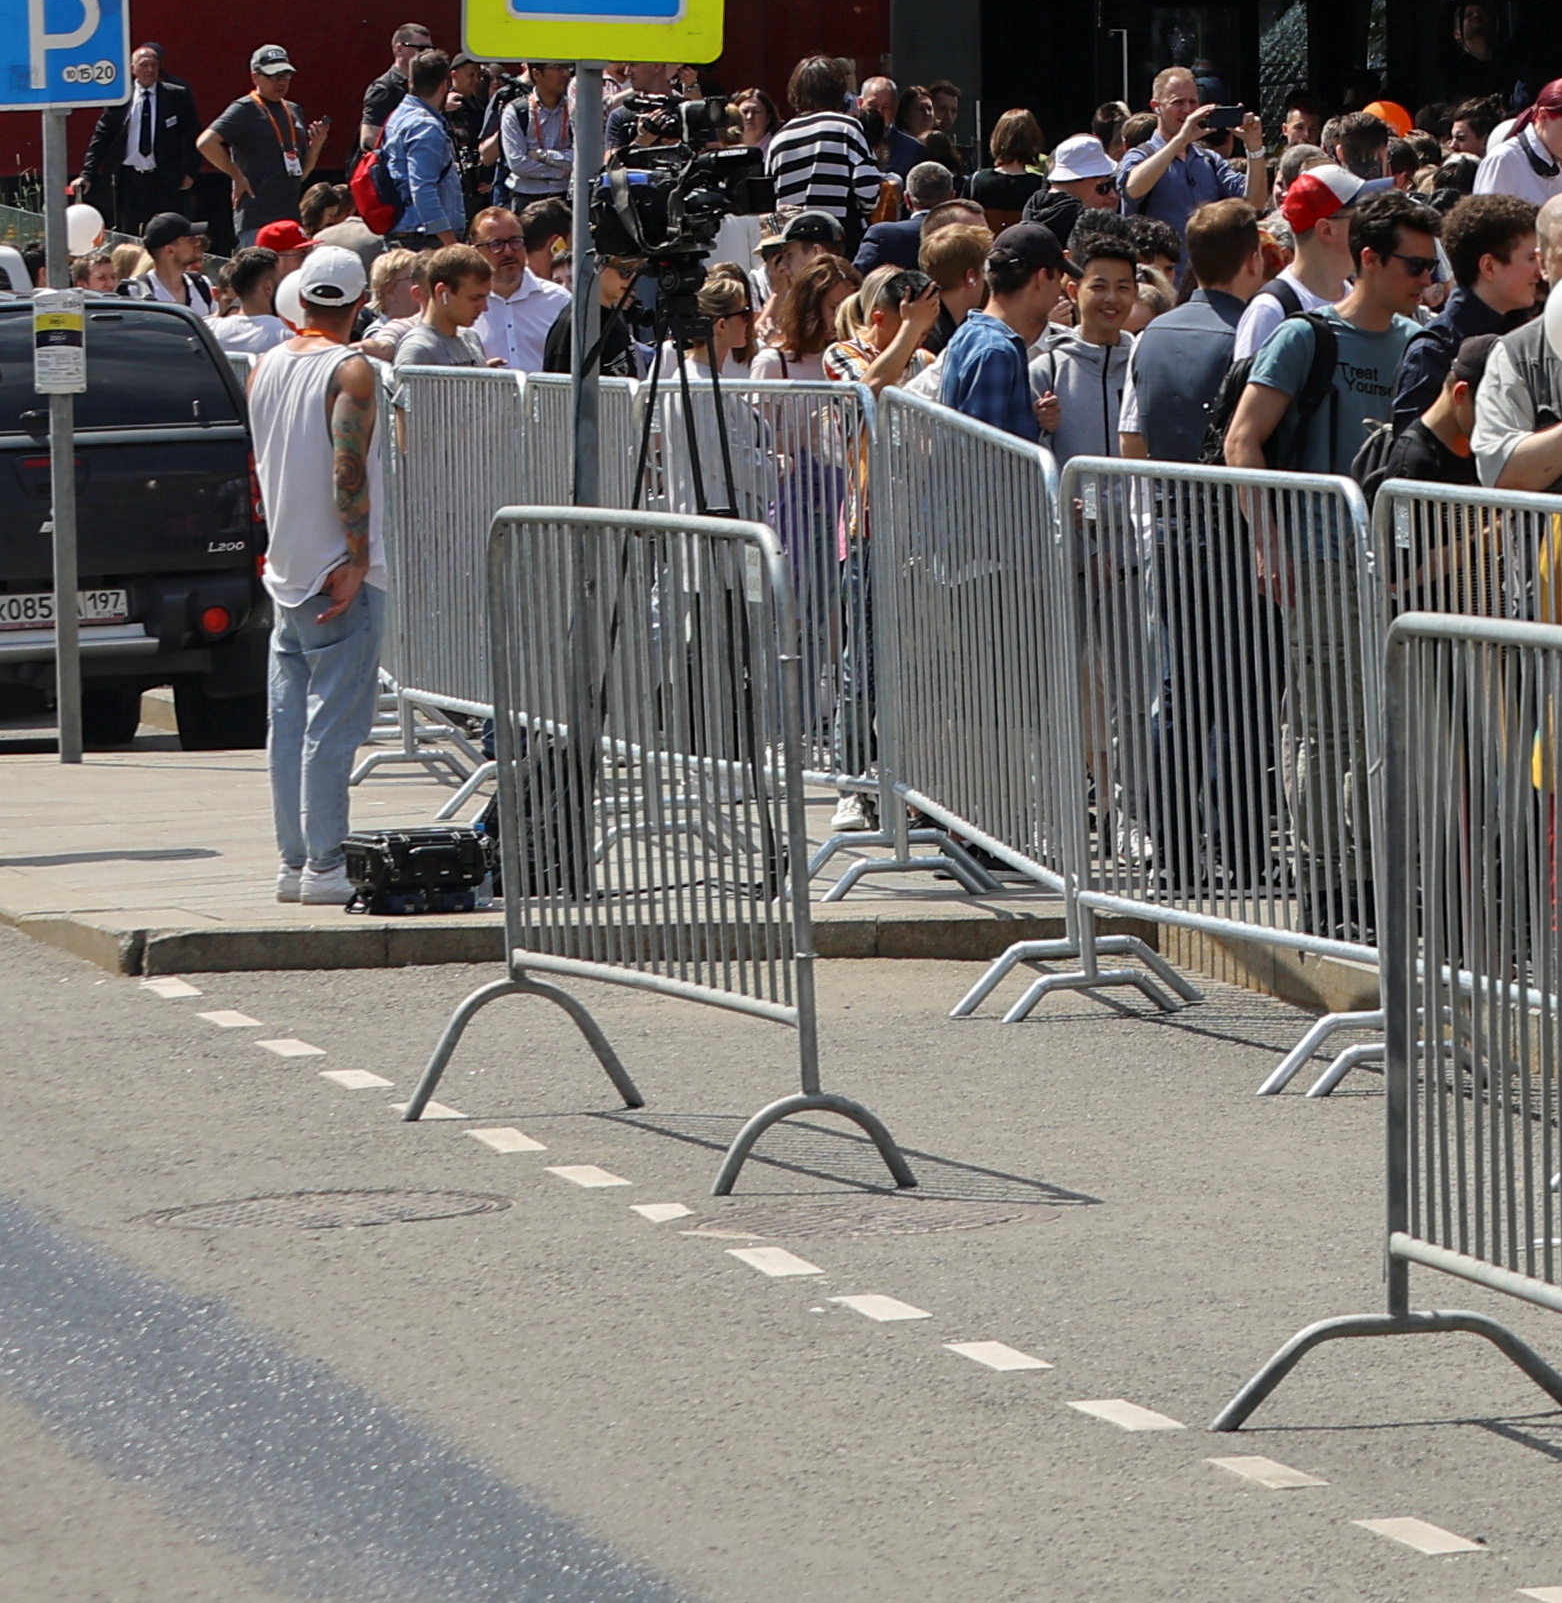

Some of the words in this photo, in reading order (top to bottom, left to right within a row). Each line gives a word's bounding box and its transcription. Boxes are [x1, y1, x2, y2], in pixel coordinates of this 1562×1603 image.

[80, 68, 91, 79] 15
[95, 66, 114, 80] 20
[1337, 362, 1378, 381] Treat
[207, 541, 245, 553] L200
[87, 592, 121, 611] 197
